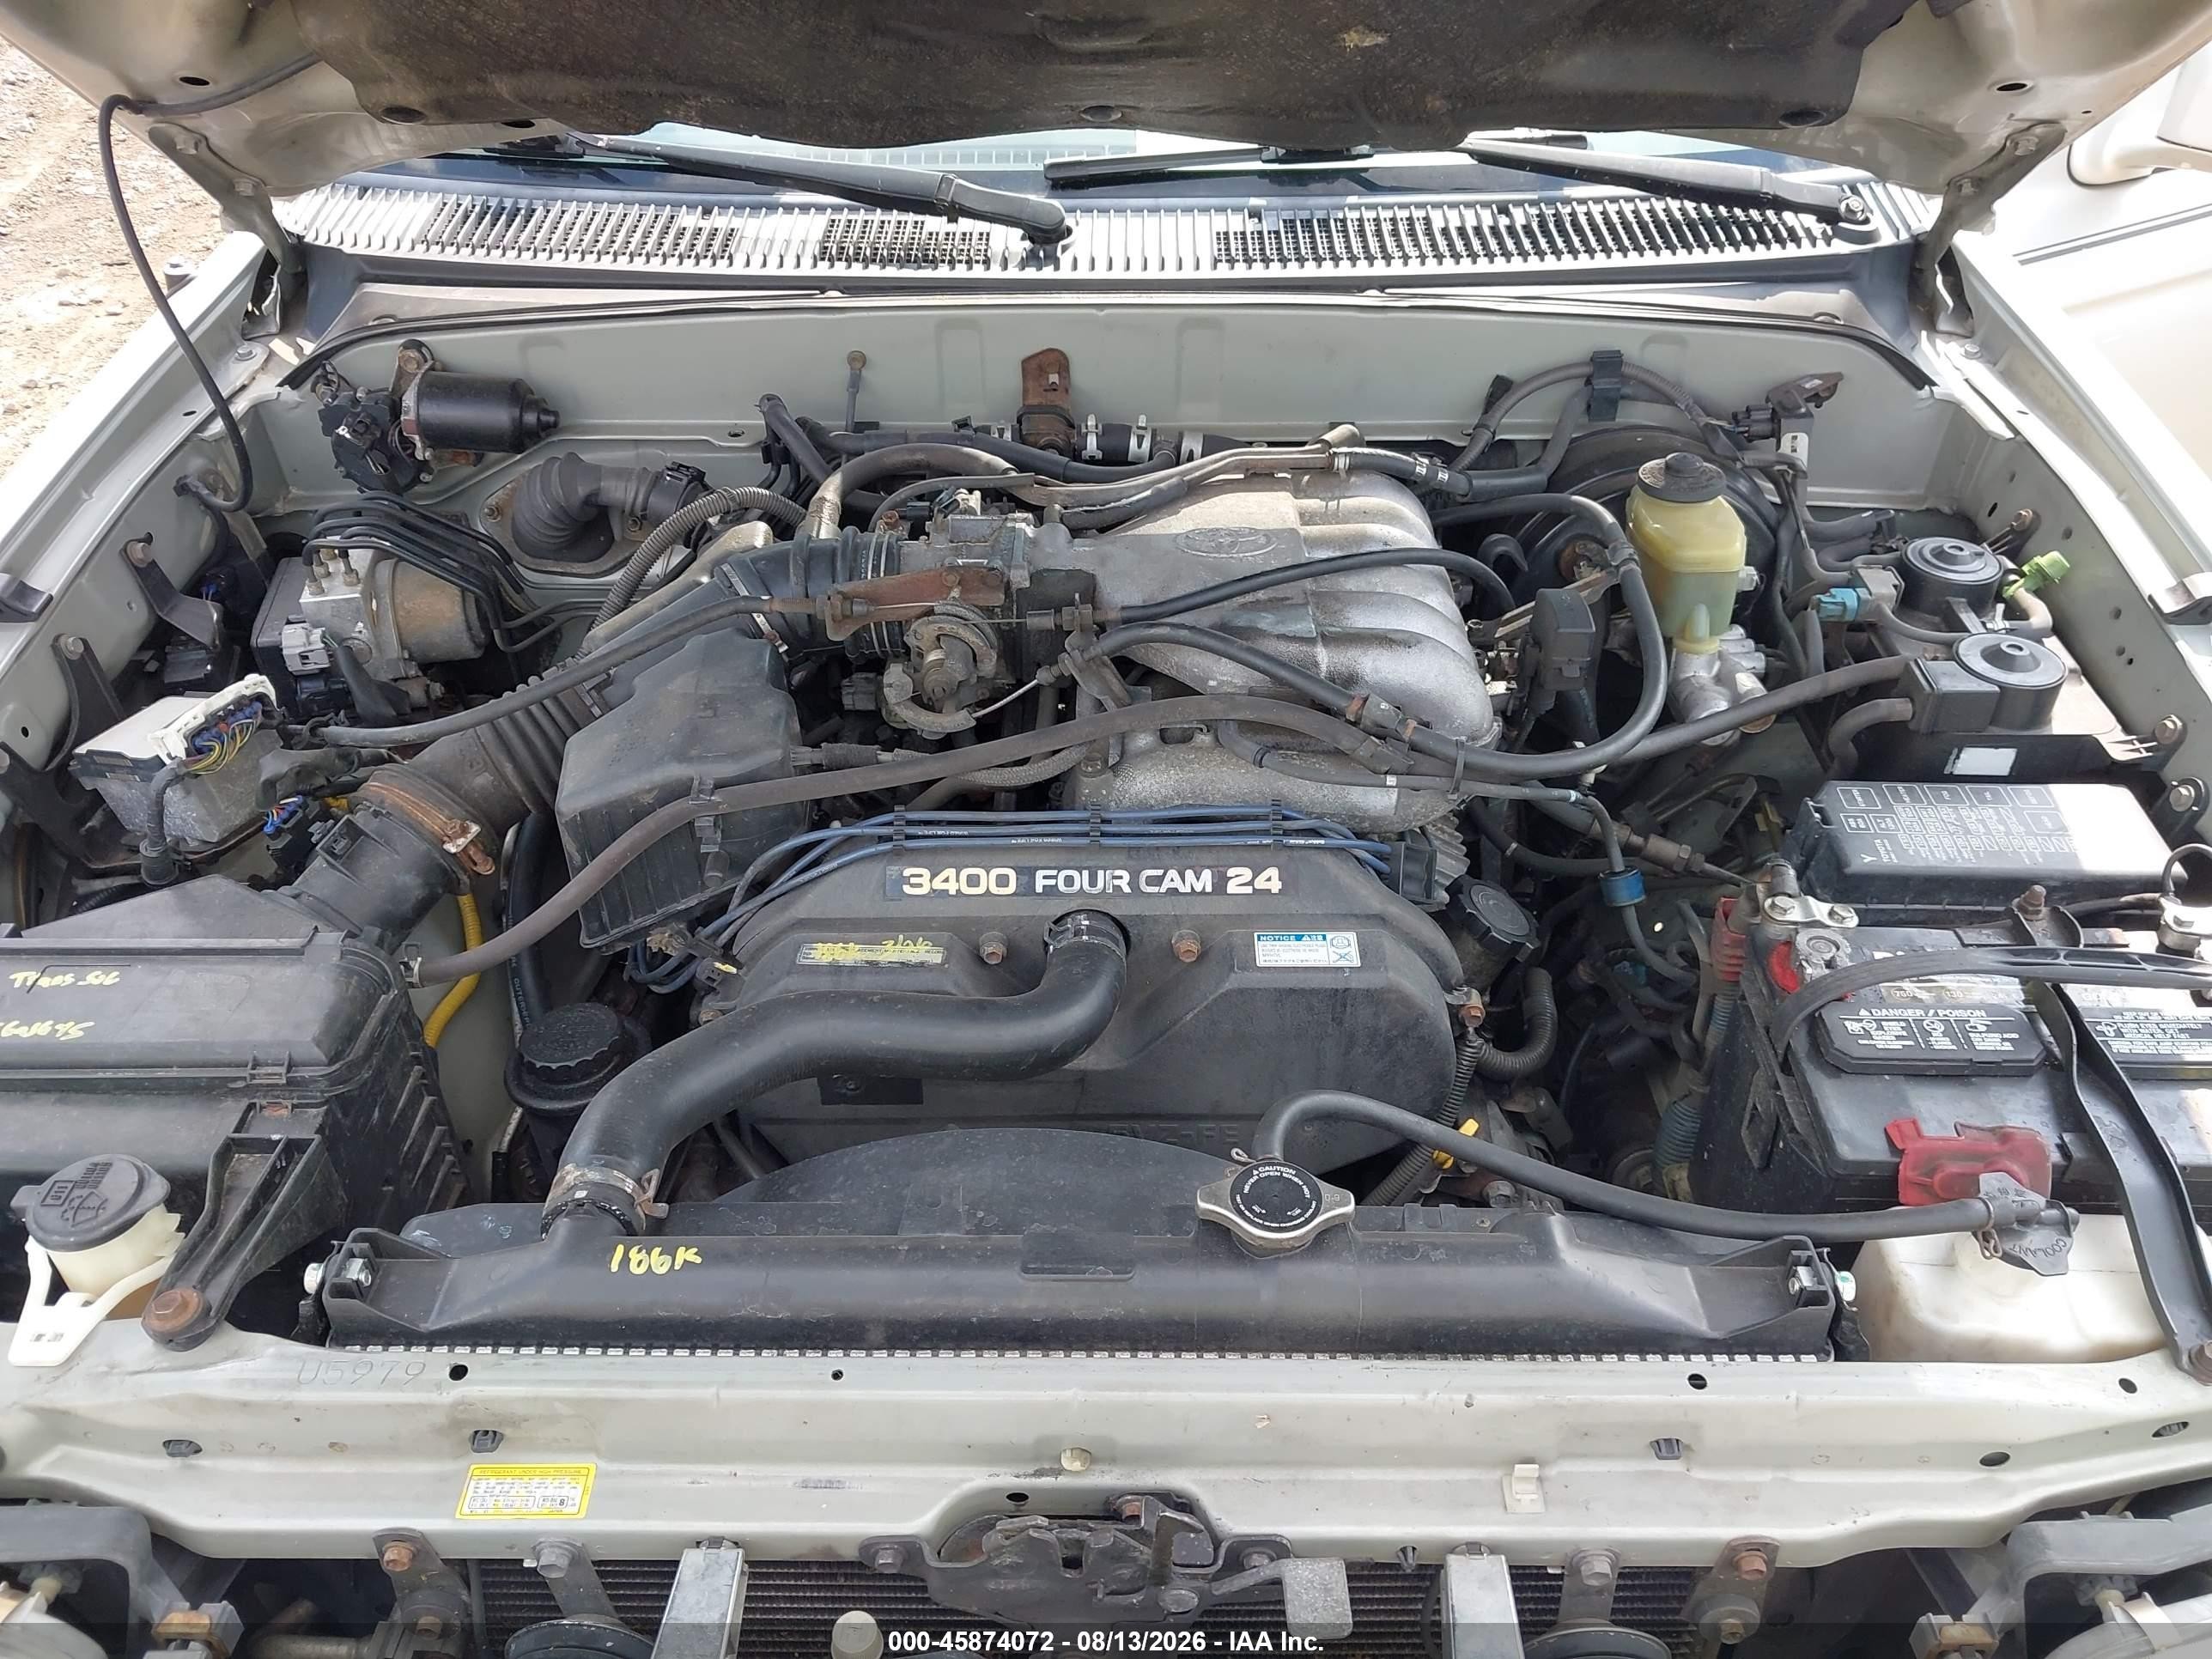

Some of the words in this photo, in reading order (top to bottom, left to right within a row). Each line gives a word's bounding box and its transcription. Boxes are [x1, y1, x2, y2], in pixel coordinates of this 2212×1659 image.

[1874, 839, 1892, 864] TOYOTA
[902, 867, 1017, 895] 3400
[1035, 869, 1129, 894] FOUR
[1139, 869, 1212, 894] CAM
[1226, 866, 1283, 894] 24
[1871, 1008, 1925, 1017] DANGER
[1936, 1009, 1987, 1018] POISON
[1258, 1166, 1297, 1175] CAUTION
[1243, 1175, 1259, 1194] NEVER
[1282, 1172, 1304, 1186] WHEN
[1302, 1185, 1310, 1199] HOT
[611, 1243, 702, 1275] 186K
[2008, 1237, 2067, 1258] COOLANT
[297, 1359, 427, 1385] U5979
